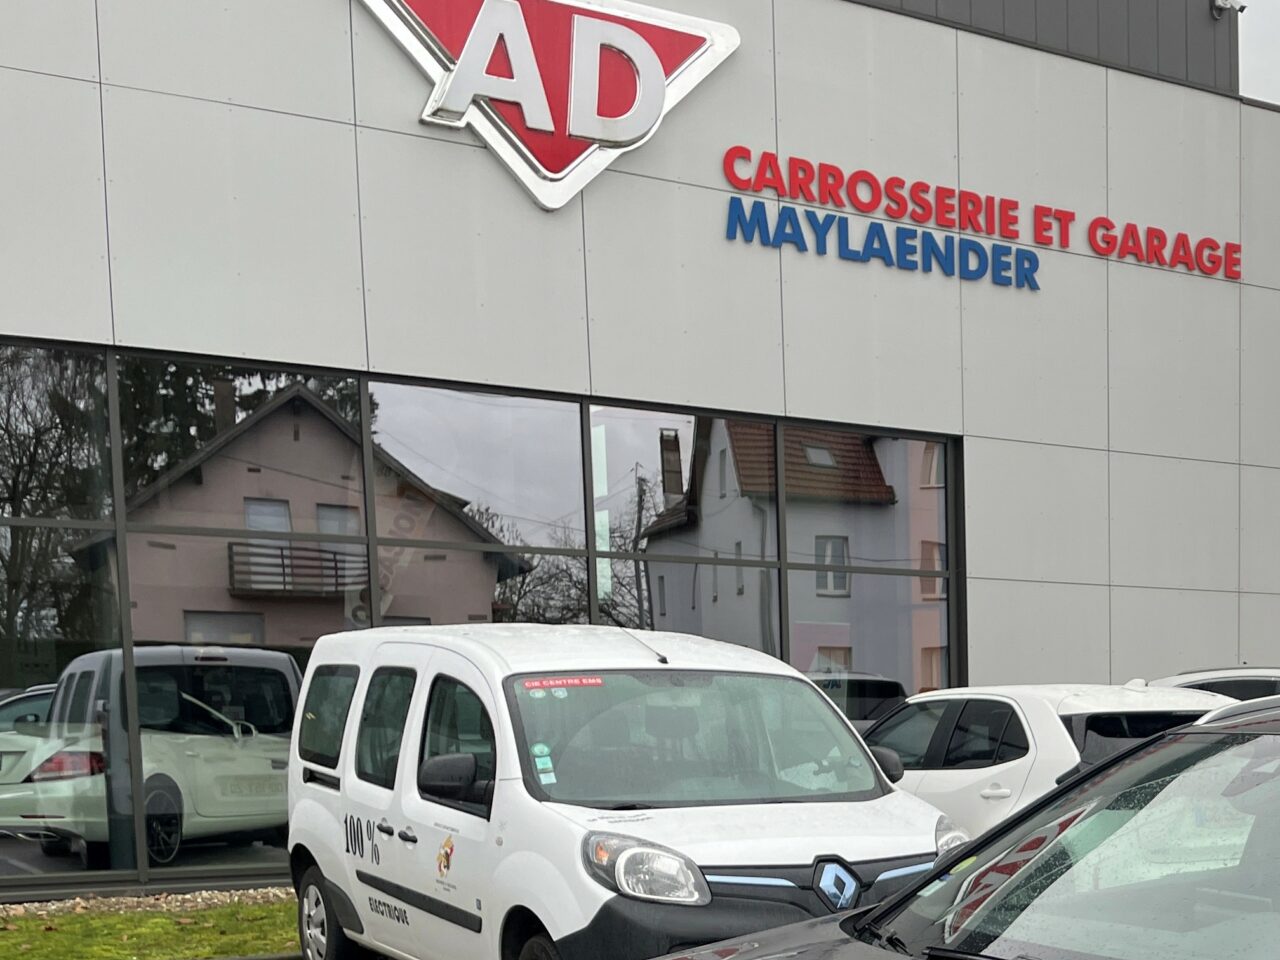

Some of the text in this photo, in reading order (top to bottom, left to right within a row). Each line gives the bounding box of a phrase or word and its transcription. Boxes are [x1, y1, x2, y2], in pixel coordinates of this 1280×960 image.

[436, 0, 666, 144] AD
[723, 146, 1242, 280] CARROSSERIE ET GARAGE
[726, 196, 1040, 291] MAYLAENDER
[344, 813, 364, 858] 100
